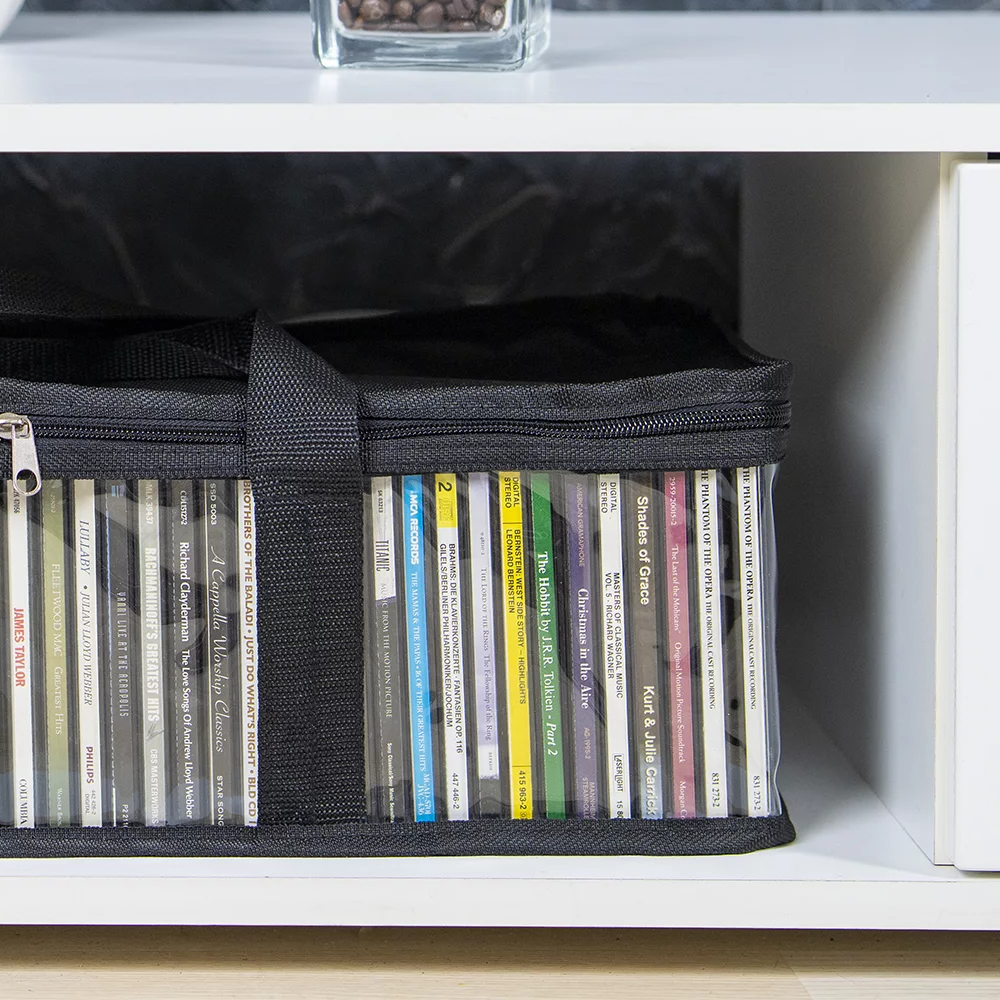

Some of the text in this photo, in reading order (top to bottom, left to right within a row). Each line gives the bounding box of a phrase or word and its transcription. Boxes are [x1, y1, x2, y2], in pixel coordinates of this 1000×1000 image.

[243, 480, 251, 539] BROTHERS
[438, 482, 452, 492] 2
[512, 477, 520, 507] DIGITAL
[244, 542, 251, 557] OF
[375, 540, 390, 572] TITANIC
[410, 494, 419, 565] MCA RECORDS
[637, 496, 651, 605] Shades of Grace
[743, 486, 754, 601] PHANTOM OPERA
[506, 529, 515, 613] LEONARD BERNSTEIN
[702, 484, 714, 649] PHANTOM OF OPERA ORIGINAL
[52, 564, 62, 656] FLEETWOOD MAC
[79, 520, 92, 705] LULLABY JULIAN LLOYD WEBBER
[145, 547, 160, 721] RACHMANINOFF'S GREATEST HITS
[245, 585, 253, 626] BALADI
[448, 543, 462, 724] BRAHMS: KLAVIERKONZERTE FANTASIEN
[14, 608, 25, 687] JAMES TAYLOR
[179, 542, 194, 818] Richard Clayderman The Love Songs Of Andrew Lloyd Webber
[210, 569, 230, 752] Cappella Worship Classics
[244, 636, 254, 662] JUST
[247, 665, 254, 682] DO
[442, 616, 453, 727] PHILHARMONIKER/JOCHUM
[538, 552, 556, 747] The Hobbit by J.R.R. Tolkien Part
[578, 588, 591, 709] Christmas in the Aire
[247, 685, 255, 729] WHAT'S
[518, 657, 526, 704] HIGHLIGHTS
[674, 642, 685, 763] Original Soundtrack
[417, 714, 425, 752] GREATEST
[485, 725, 493, 740] Ring
[643, 686, 658, 815] Kurt & Julie Carrick
[86, 747, 94, 784] PHILIPS
[151, 766, 159, 824] MASTERWORKS
[248, 777, 256, 799] BLD
[678, 781, 687, 808] Morgan
[19, 779, 27, 824] COLUMBIA
